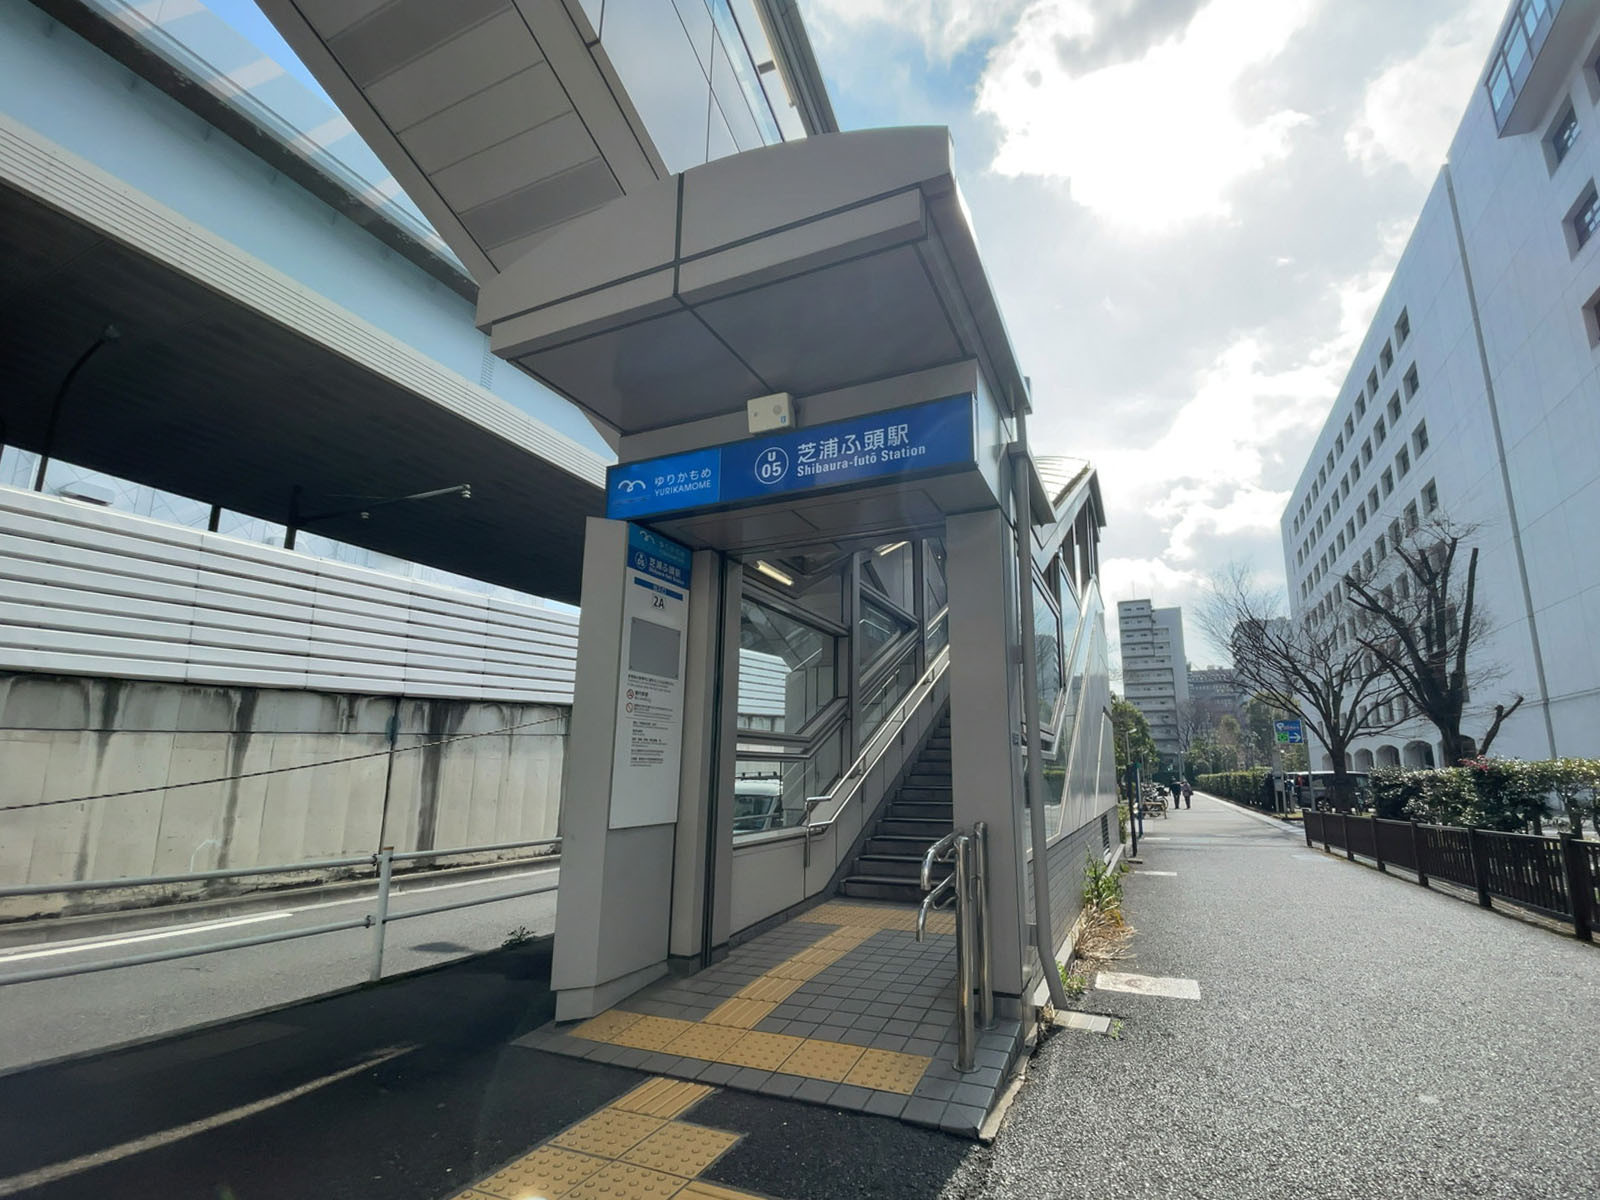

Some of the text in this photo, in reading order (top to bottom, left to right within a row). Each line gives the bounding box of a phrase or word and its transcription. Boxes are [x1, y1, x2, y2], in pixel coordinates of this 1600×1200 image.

[797, 423, 909, 464] 芝浦ふ頭駅
[767, 451, 777, 462] U
[797, 445, 927, 477] Shibaura-futō Station
[654, 468, 712, 487] ゆりかもめ
[761, 462, 782, 479] 05
[654, 479, 712, 497] YURIKAMOME
[653, 595, 665, 609] 2A
